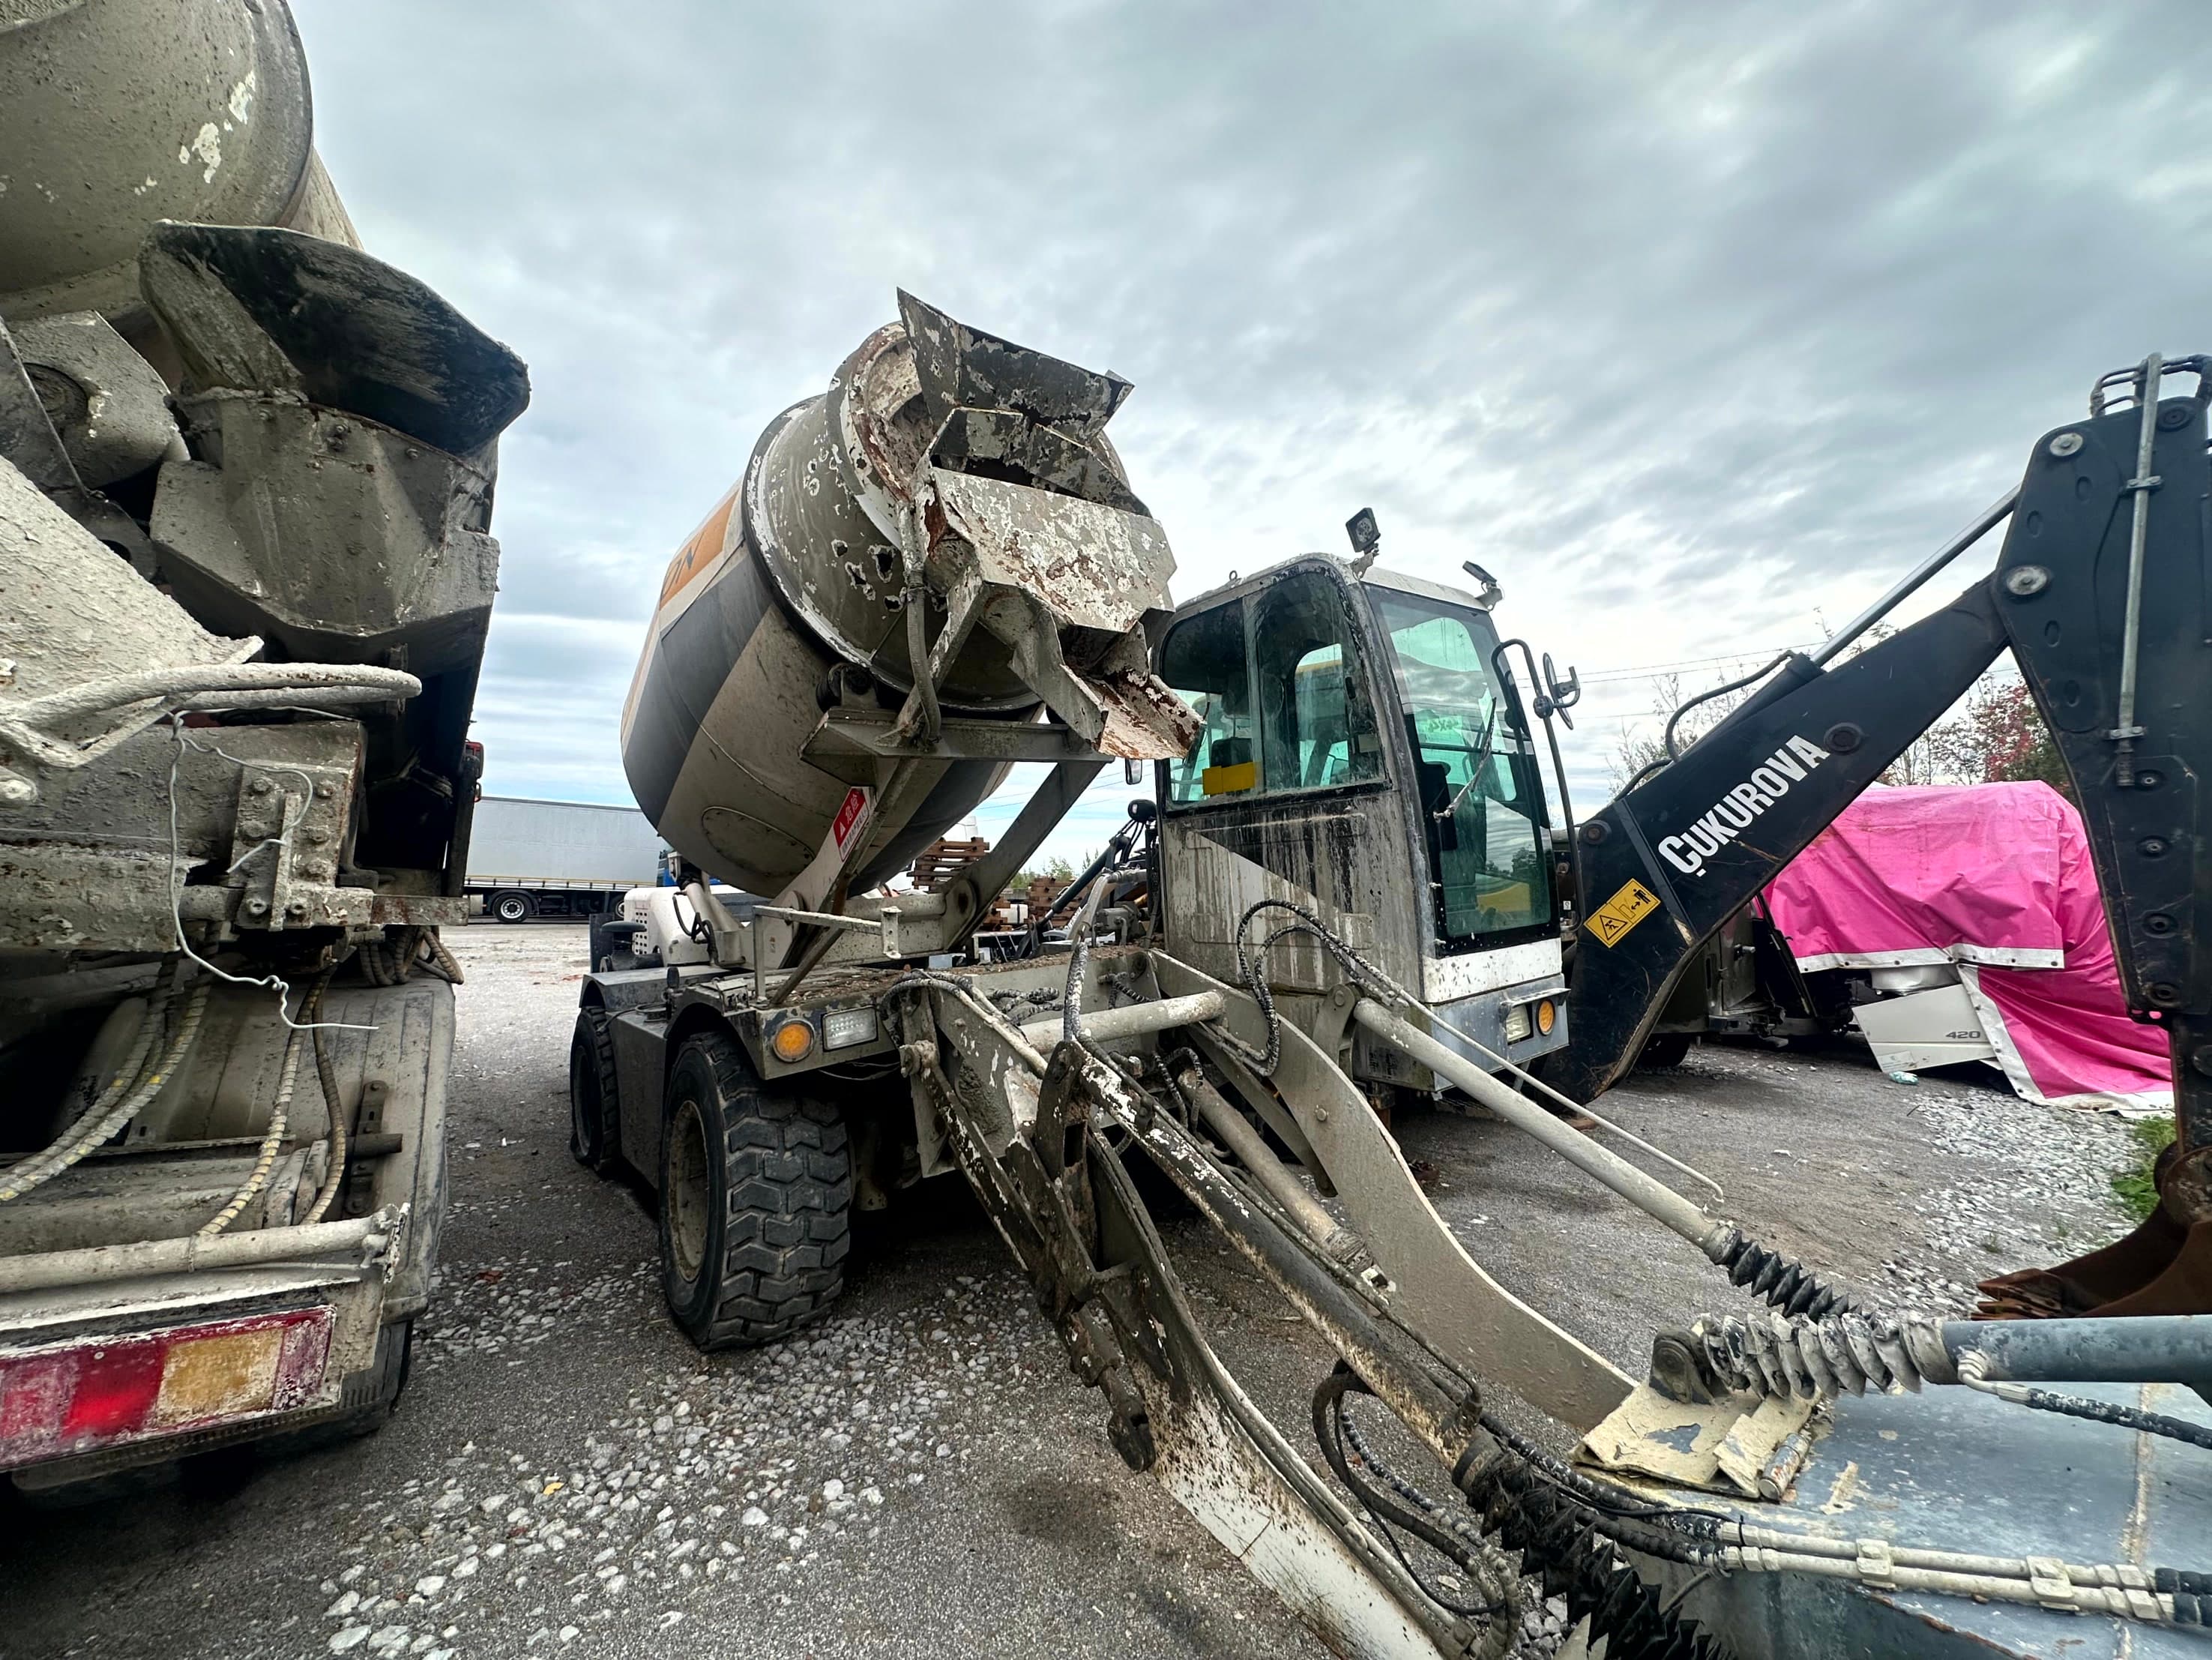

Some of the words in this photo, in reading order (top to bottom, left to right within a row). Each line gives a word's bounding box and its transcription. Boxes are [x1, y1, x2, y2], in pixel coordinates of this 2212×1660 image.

[845, 793, 860, 825] 危险
[1658, 735, 1830, 877] ÇUKUROVA
[1945, 1030, 1981, 1039] 420
